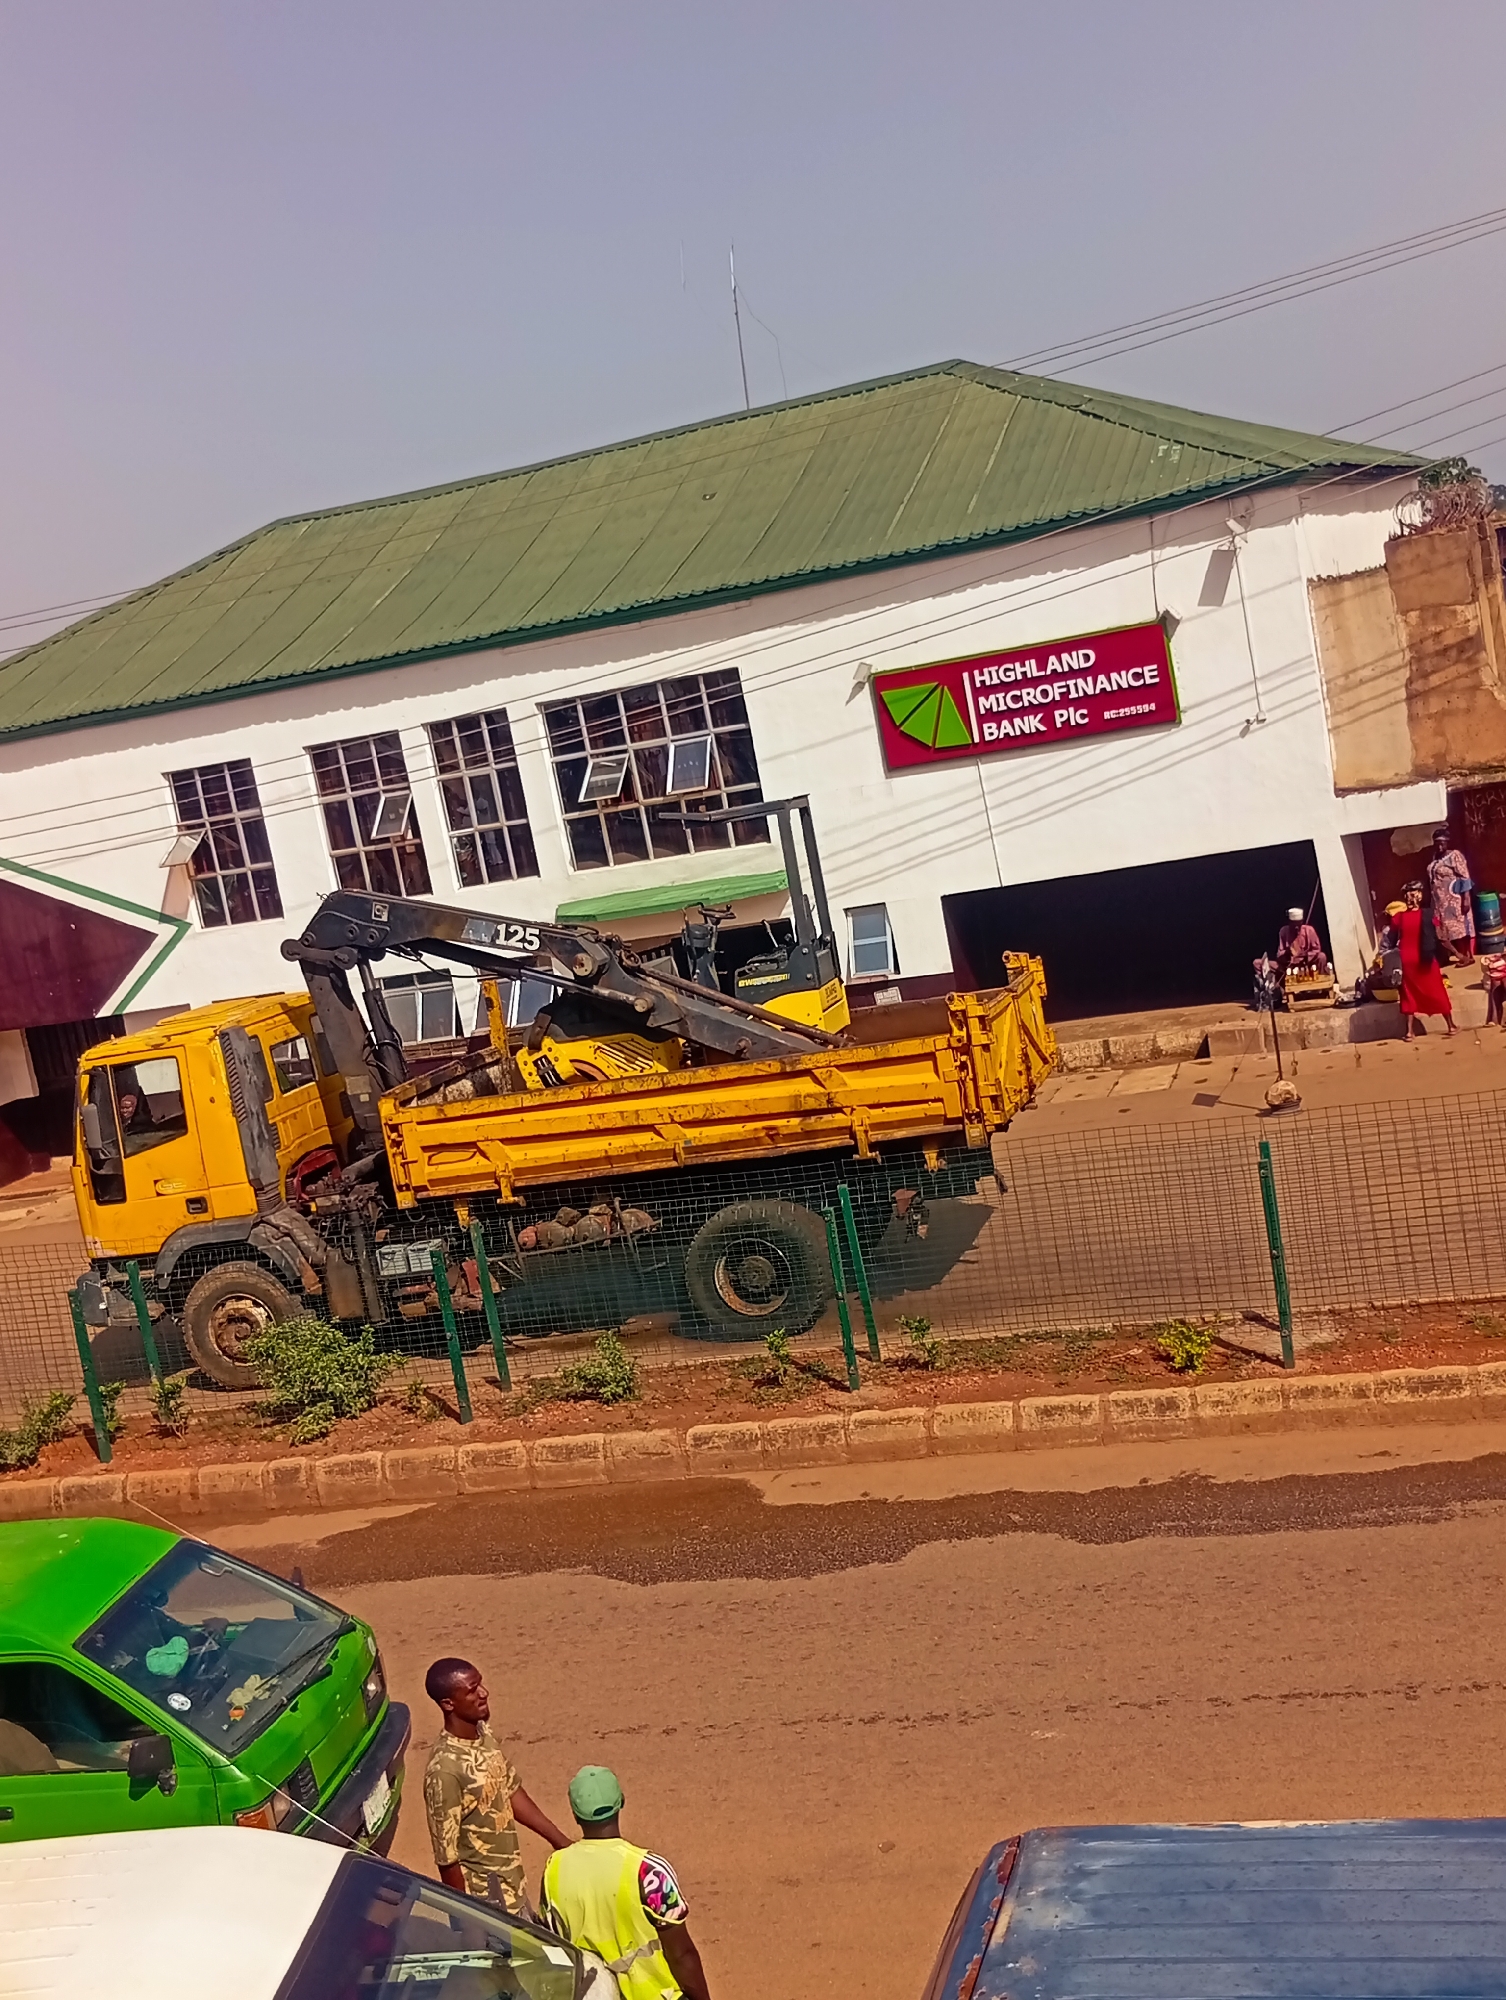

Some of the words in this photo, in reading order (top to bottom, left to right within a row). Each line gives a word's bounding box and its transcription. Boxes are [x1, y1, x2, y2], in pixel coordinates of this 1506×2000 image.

[973, 649, 1096, 687] HIGHLAND
[978, 664, 1160, 714] MICROFINANCE
[982, 713, 1047, 741] BANK
[1054, 707, 1089, 728] Plc
[495, 923, 541, 951] 125
